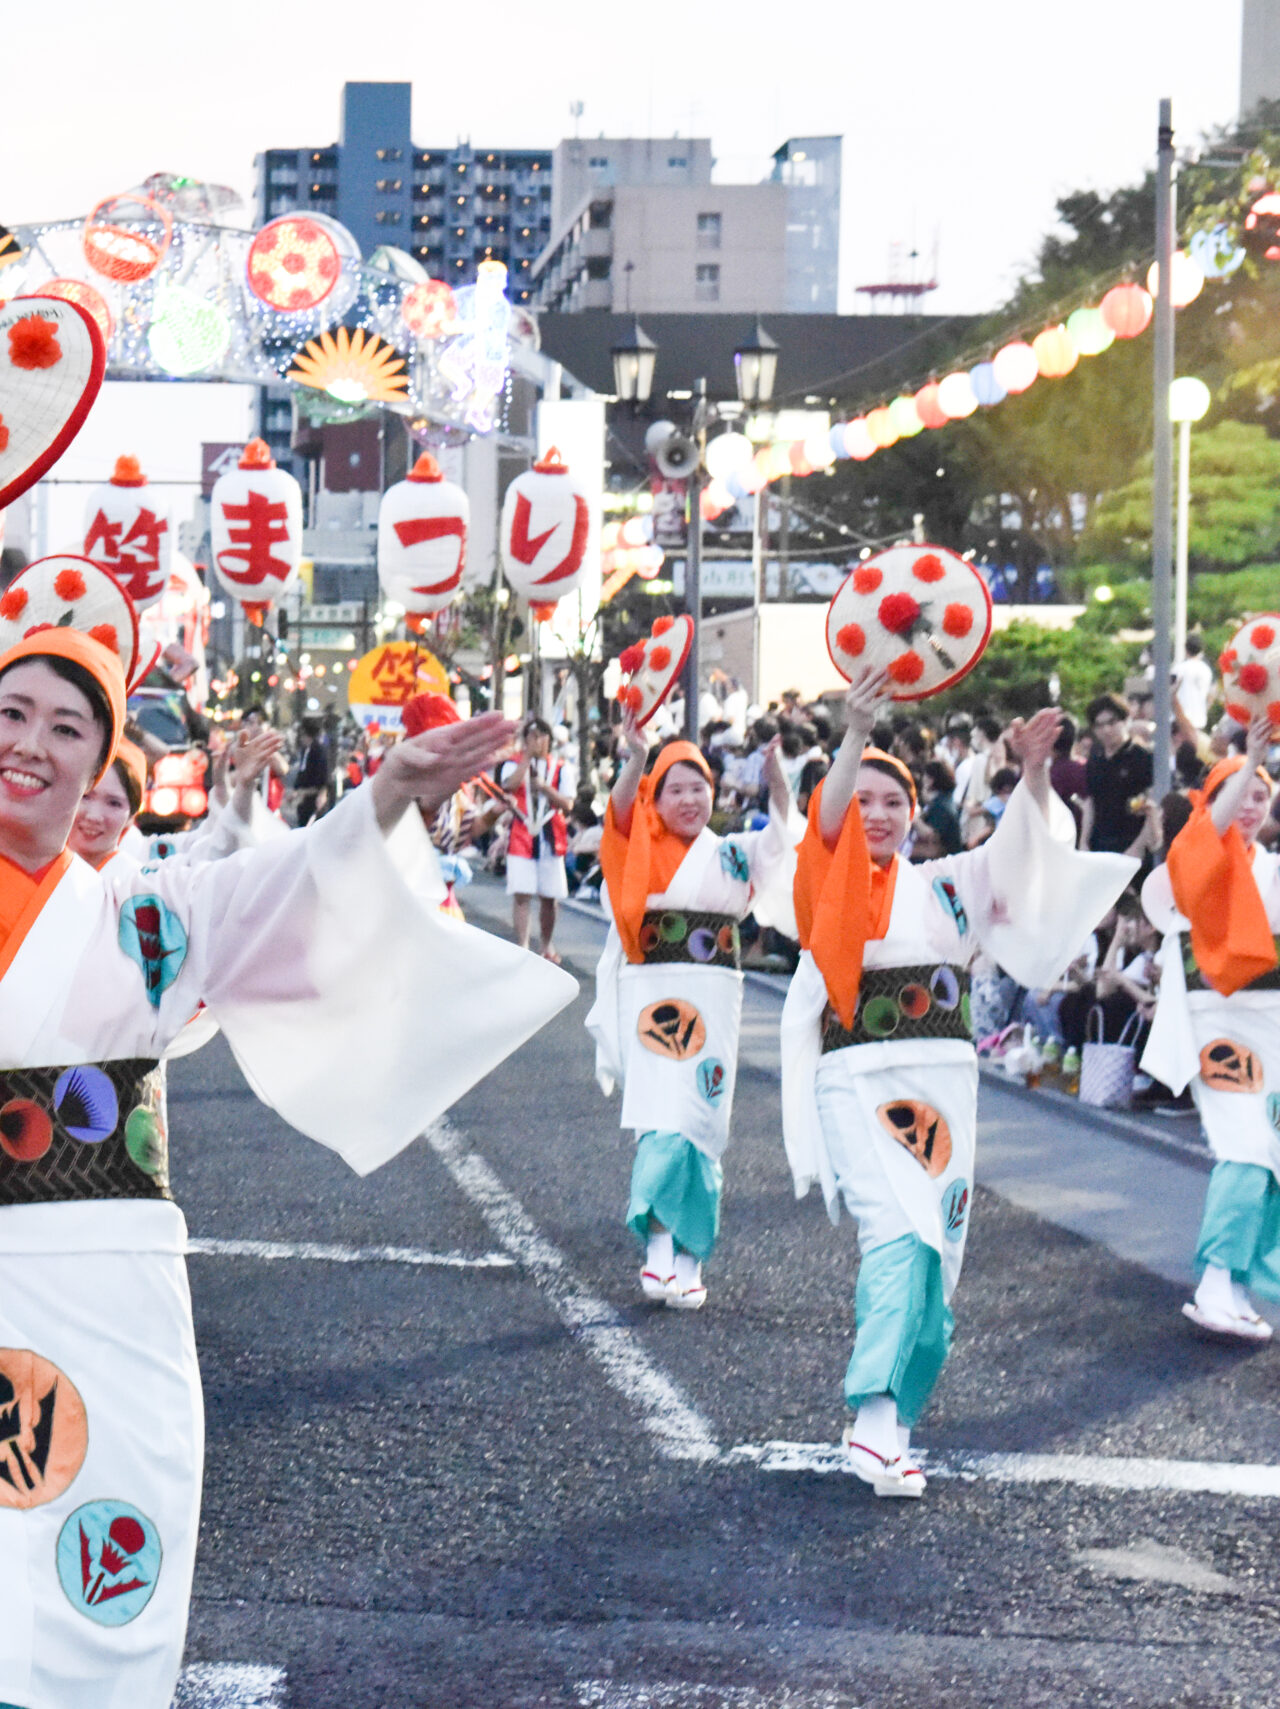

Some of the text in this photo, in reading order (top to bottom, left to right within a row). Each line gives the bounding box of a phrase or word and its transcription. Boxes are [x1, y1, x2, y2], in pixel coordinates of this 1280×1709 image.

[84, 507, 168, 601] 笠
[216, 490, 292, 585] ま
[393, 516, 467, 595] つ
[509, 490, 589, 585] り
[370, 646, 427, 707] 笠
